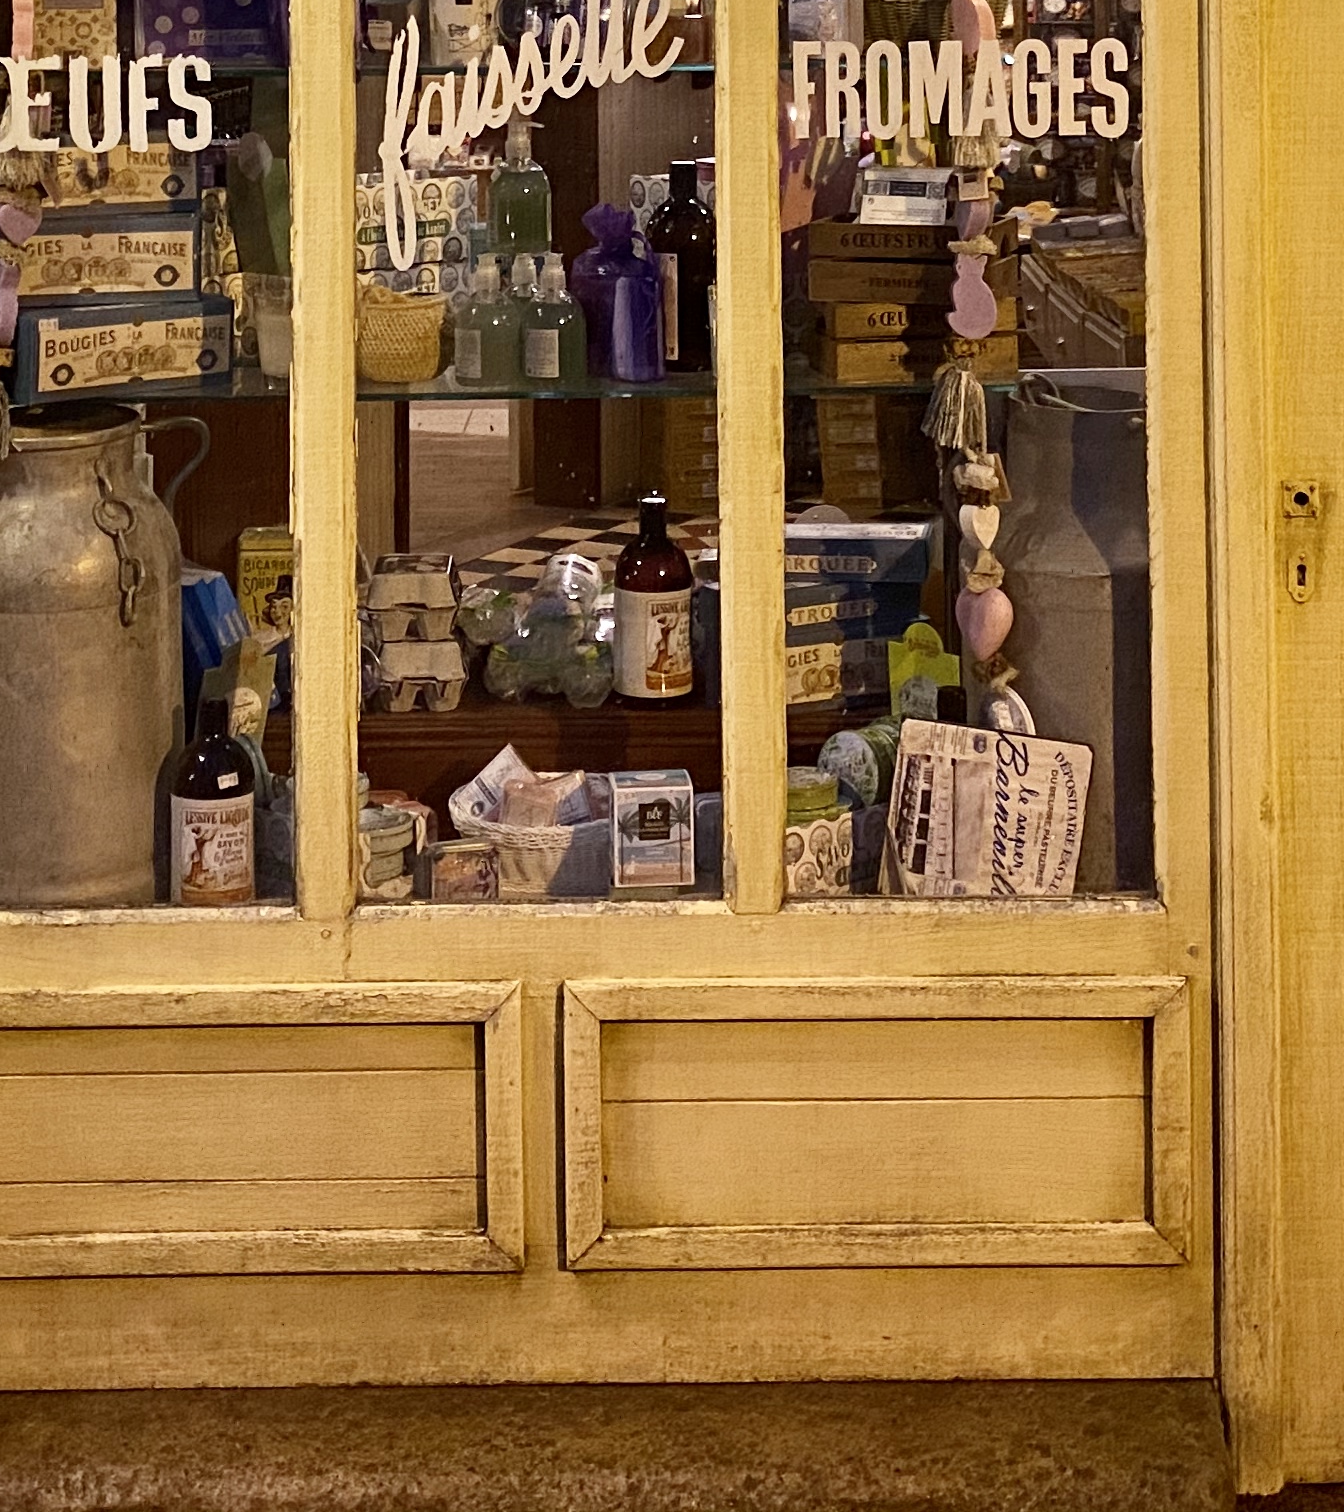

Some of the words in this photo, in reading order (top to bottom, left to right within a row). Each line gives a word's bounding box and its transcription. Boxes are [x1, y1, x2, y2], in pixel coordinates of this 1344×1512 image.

[792, 37, 1130, 141] FROMAGES
[44, 329, 117, 359] BOUGIES
[1016, 783, 1040, 806] le
[1005, 812, 1027, 869] super
[1047, 849, 1072, 895] EXCLU
